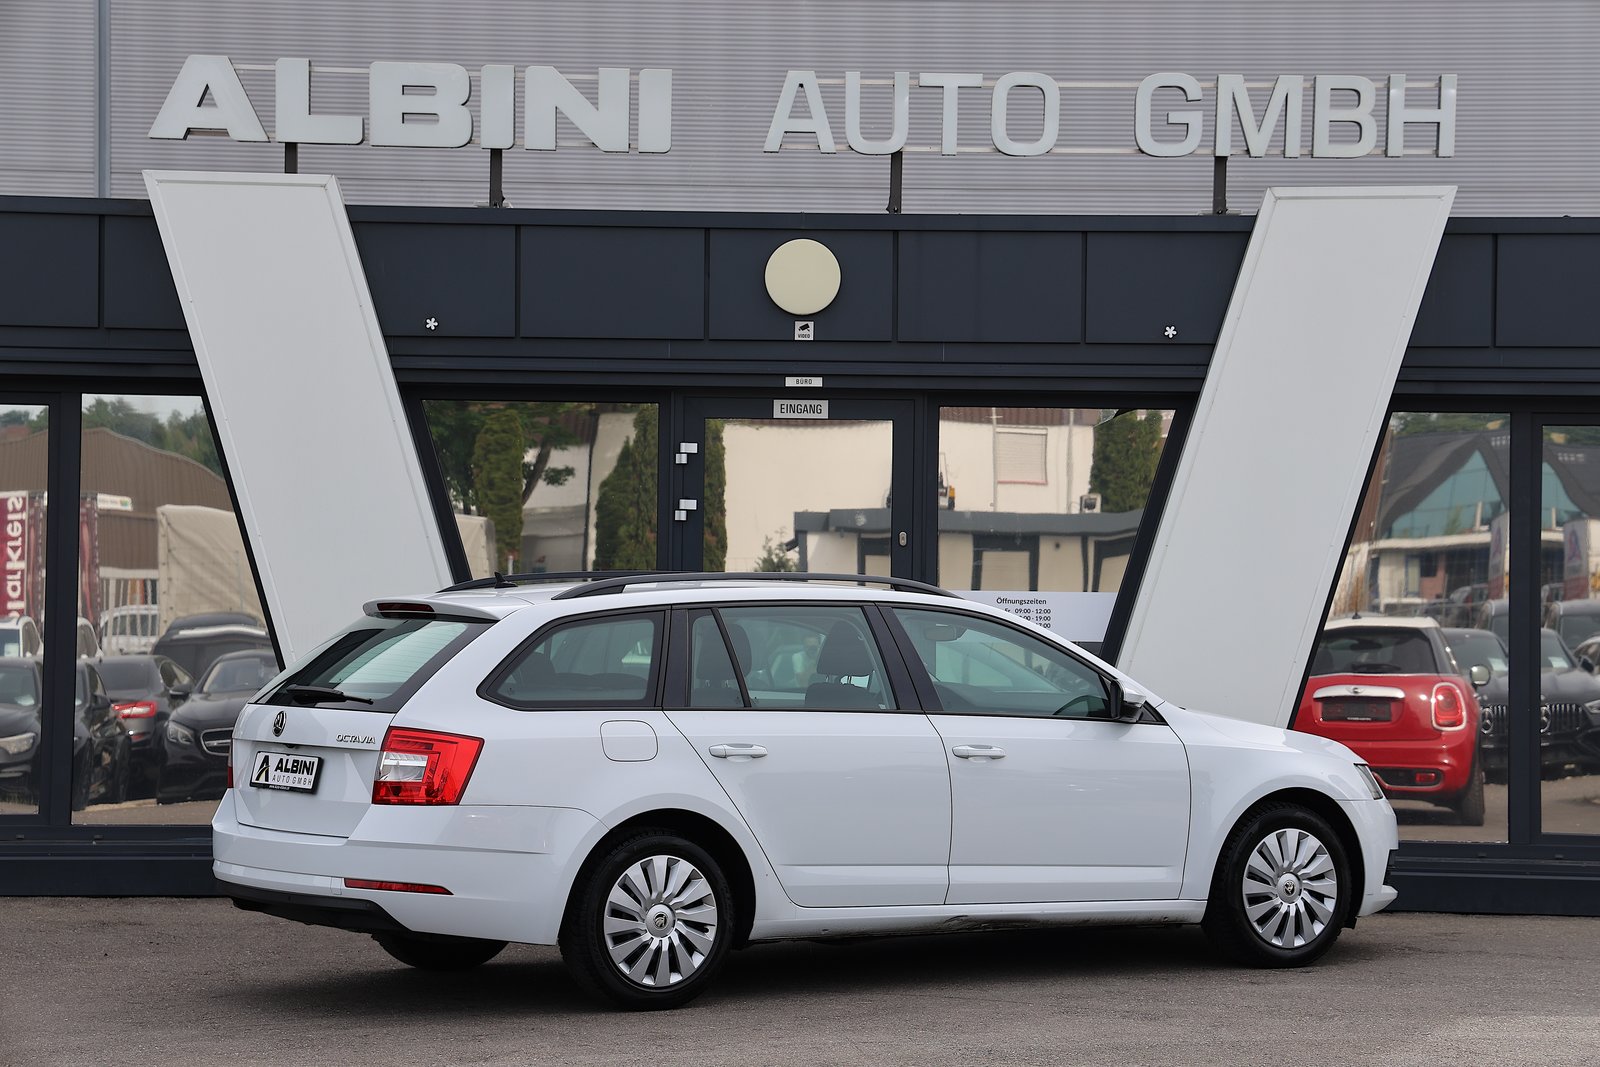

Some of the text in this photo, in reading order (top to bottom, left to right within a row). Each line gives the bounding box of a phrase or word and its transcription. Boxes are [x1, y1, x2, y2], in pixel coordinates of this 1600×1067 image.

[148, 54, 1458, 159] ALBINI AUTO GMBH
[780, 403, 822, 415] EINGANG
[996, 597, 1047, 605] Öffnungszeiten
[336, 734, 376, 744] OCTAVIA
[274, 757, 315, 776] ALBINI
[272, 775, 312, 786] AUTO GMBH
